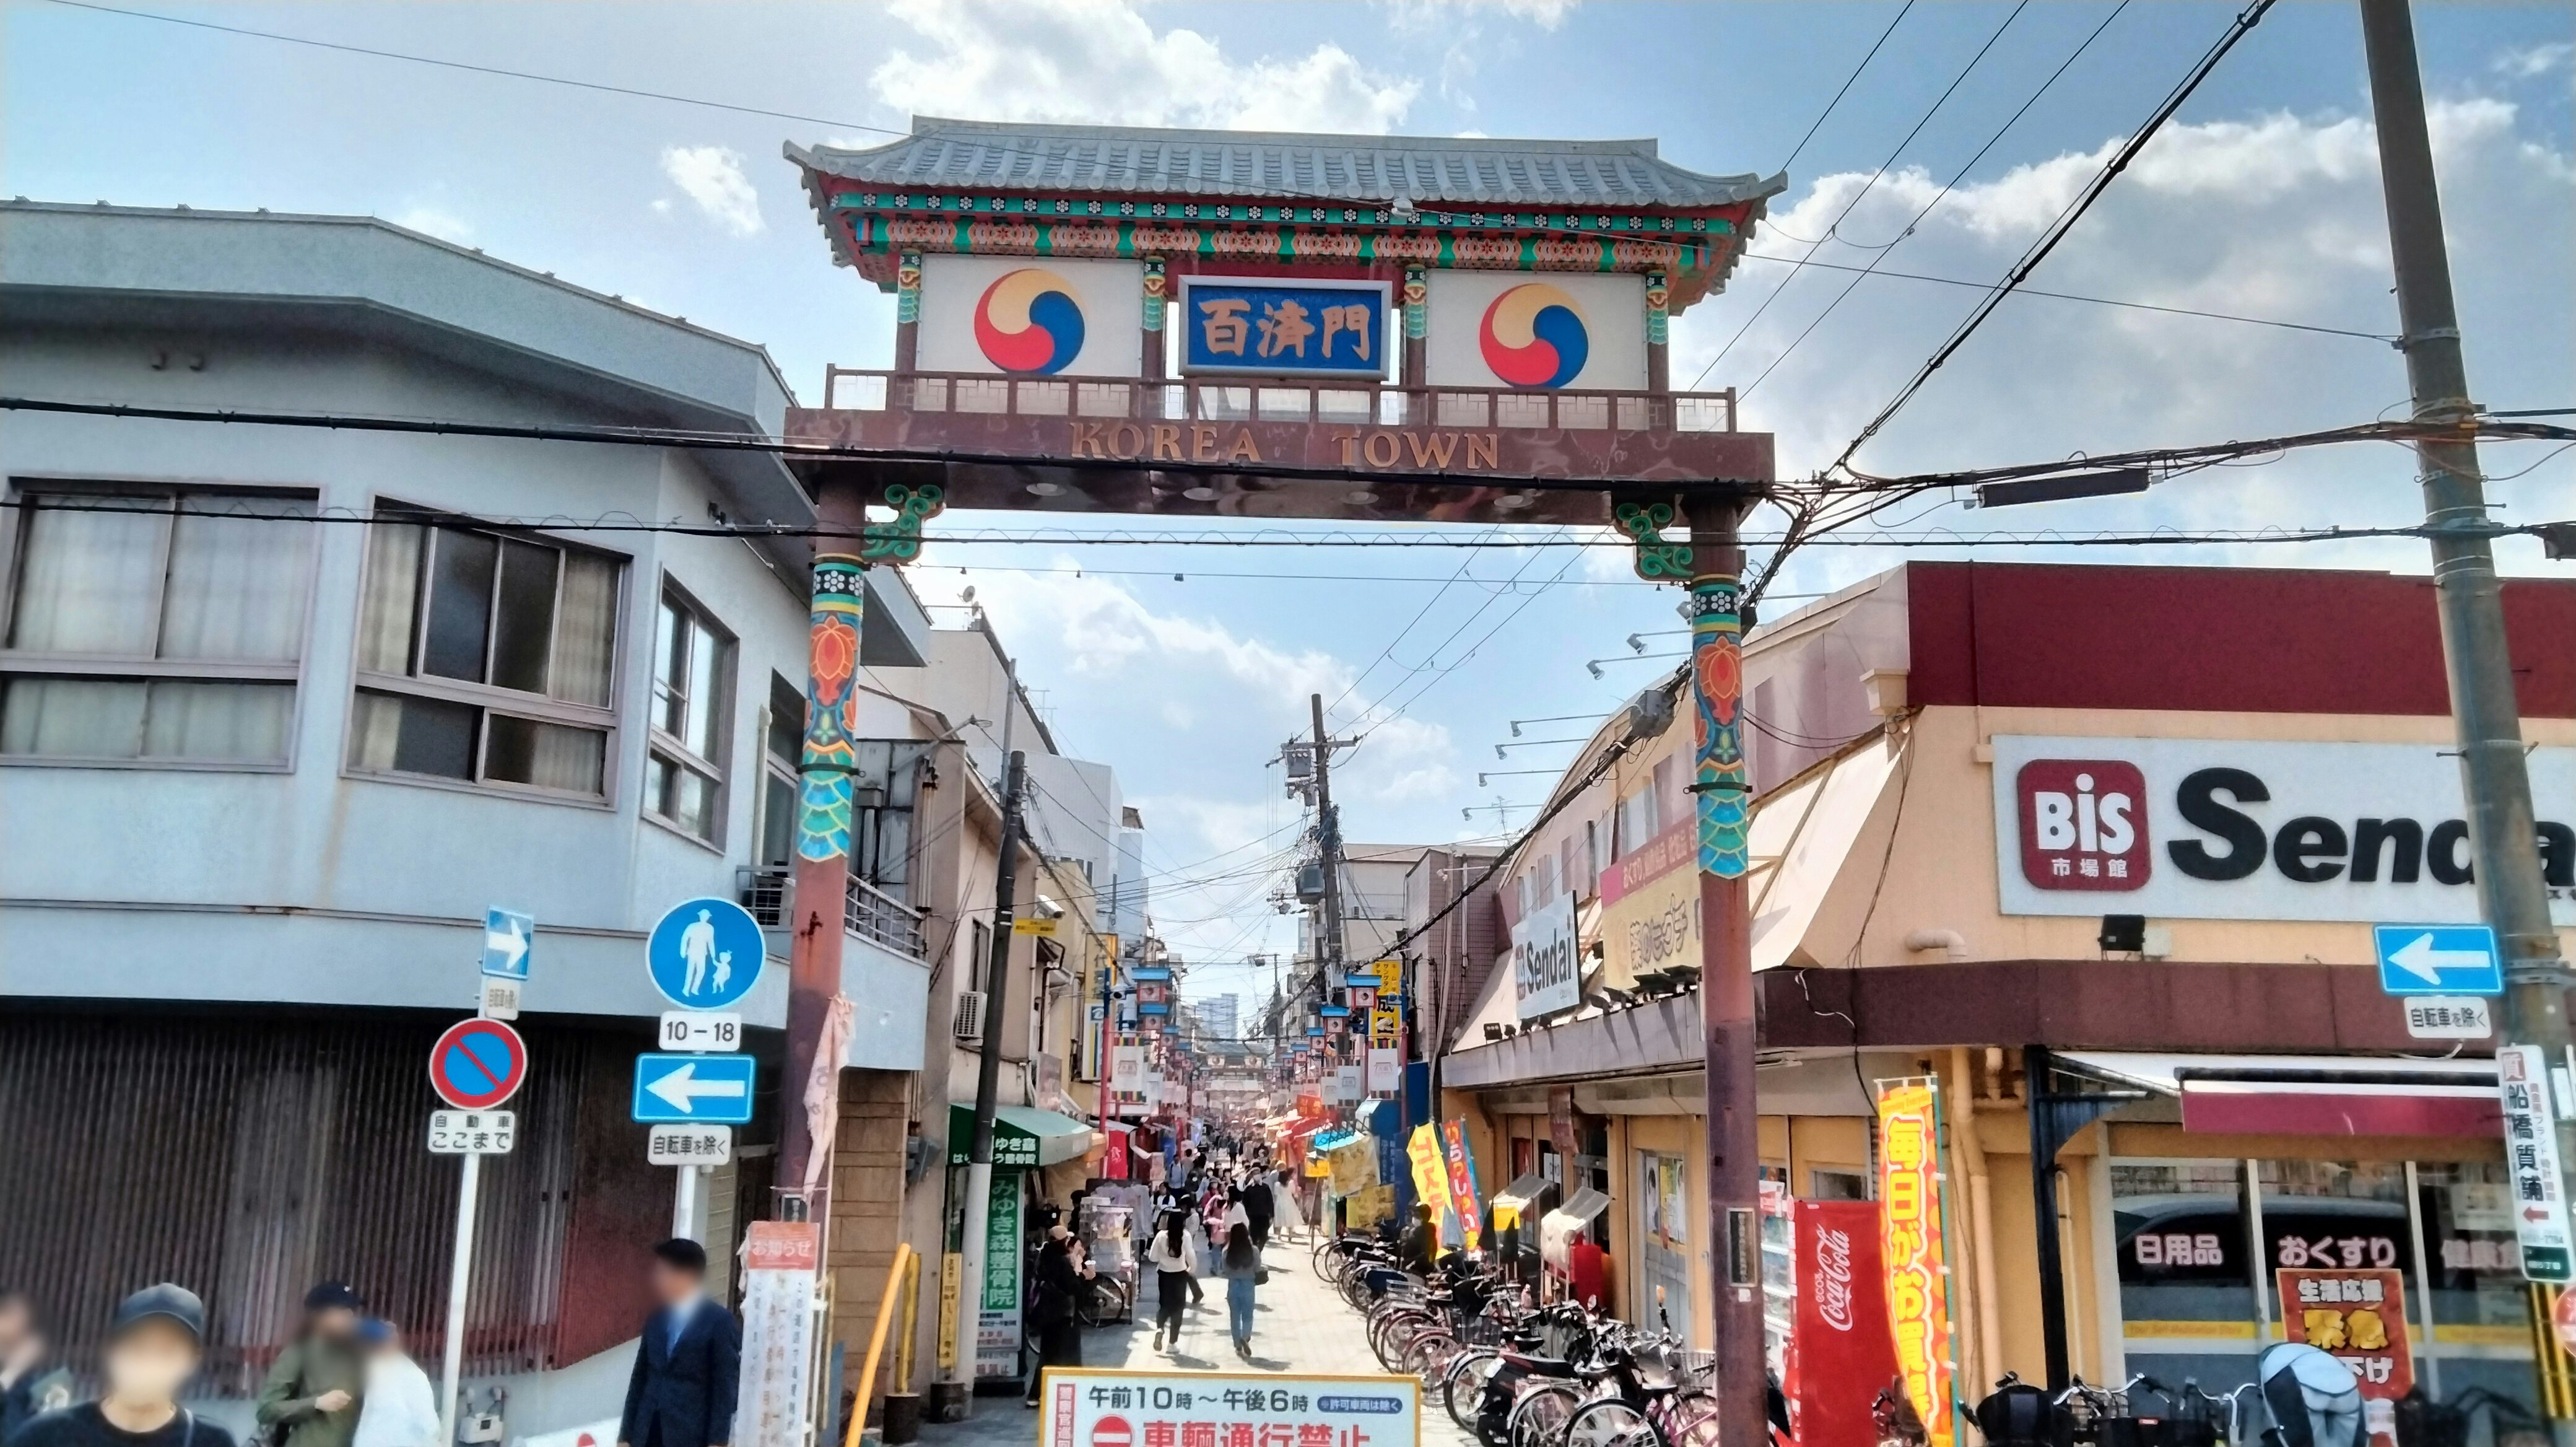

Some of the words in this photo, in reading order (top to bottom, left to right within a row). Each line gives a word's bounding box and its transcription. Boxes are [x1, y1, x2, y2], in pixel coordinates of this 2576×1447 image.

[1198, 298, 1371, 362] 百済門
[1069, 422, 1262, 463] KOREA
[1331, 430, 1499, 470] TOWN
[2052, 859, 2128, 878] 市場館
[1526, 913, 1572, 995] Sendai
[2411, 1007, 2486, 1028] 自転車を除く
[435, 1114, 510, 1129] 自動車
[432, 1131, 510, 1150] ここまで
[653, 1135, 725, 1155] 自転車を除く
[991, 1137, 1037, 1152] ゆき森
[751, 1239, 814, 1259] お知らせ
[989, 1179, 1016, 1306] みゆき森整骨院
[2136, 1235, 2223, 1266] 日用品
[2278, 1235, 2396, 1268] おくすり
[1817, 1223, 1853, 1331] Coca-Cola
